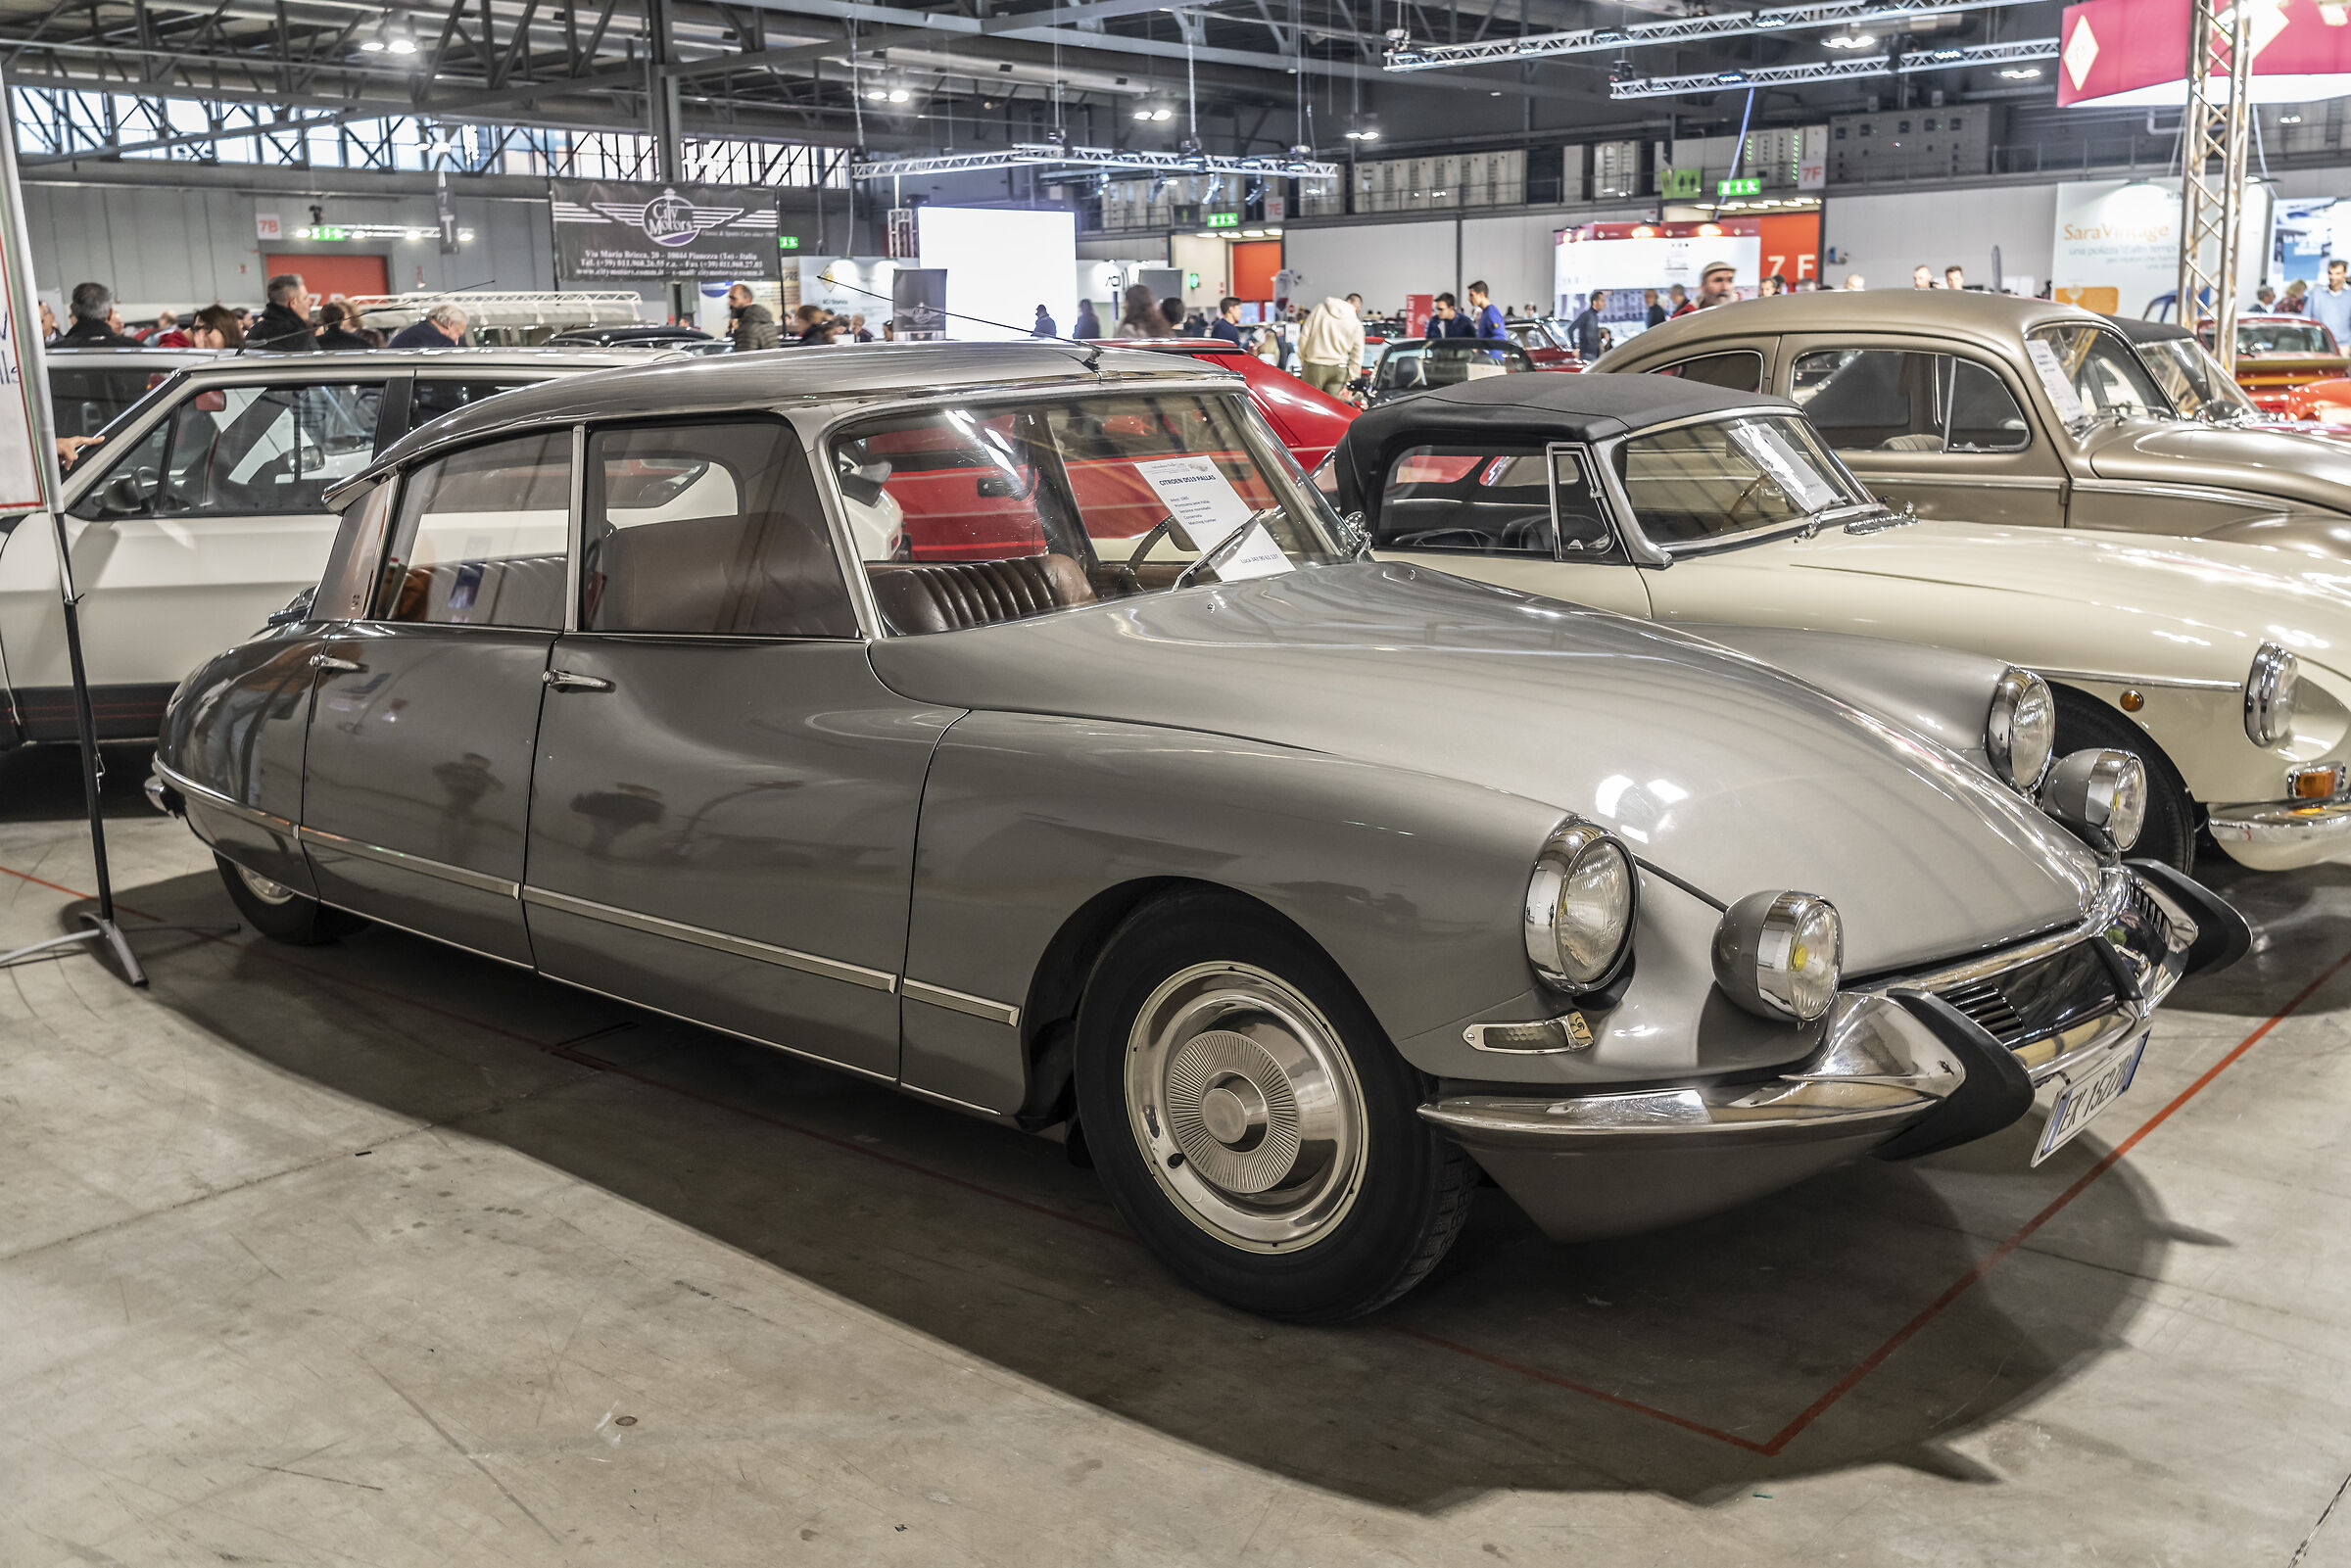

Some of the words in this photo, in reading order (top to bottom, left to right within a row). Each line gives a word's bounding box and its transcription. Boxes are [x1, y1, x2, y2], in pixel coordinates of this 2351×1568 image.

[1802, 166, 1823, 181] 7F
[652, 201, 679, 219] City
[1268, 203, 1282, 215] 7E
[259, 219, 278, 233] 7B
[441, 214, 455, 243] T
[648, 216, 694, 234] Motors
[585, 250, 599, 259] Via
[600, 250, 623, 259] Maria
[597, 259, 615, 267] (+39)
[1767, 256, 1786, 277] 7
[1797, 255, 1815, 279] F
[1159, 478, 1183, 487] CITROEN
[2059, 1087, 2087, 1133] EK
